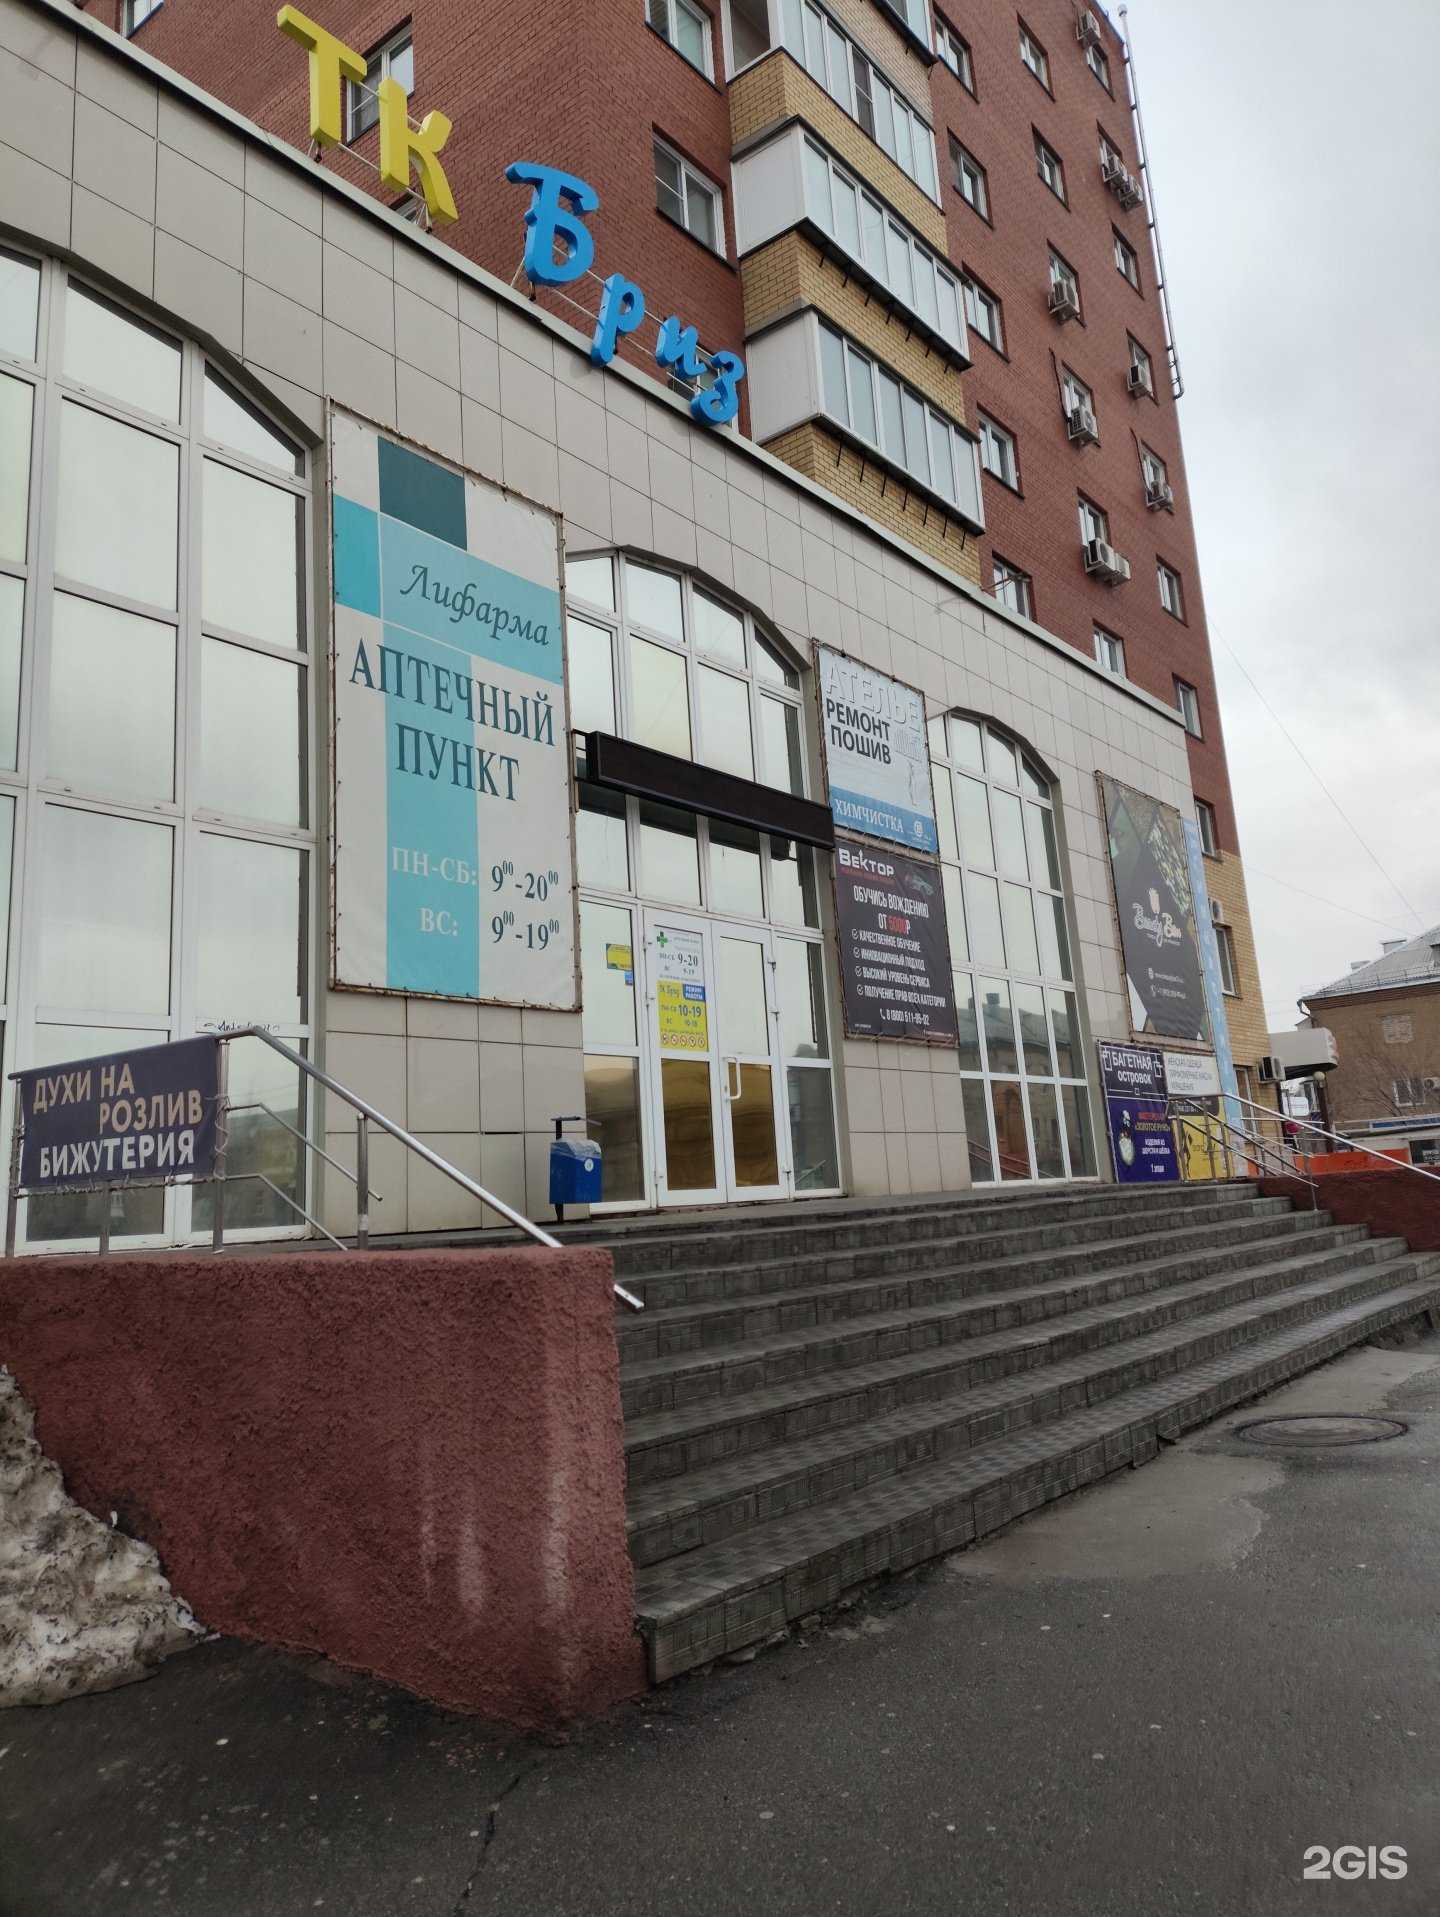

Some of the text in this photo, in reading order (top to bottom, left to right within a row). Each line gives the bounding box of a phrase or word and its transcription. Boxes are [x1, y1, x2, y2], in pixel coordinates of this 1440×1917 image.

[277, 4, 745, 427] ТК Бриз
[400, 563, 549, 647] Лифарма
[349, 636, 556, 748] АПТЕЧНЫЙ
[826, 698, 891, 741] РЕМОНТ
[395, 722, 520, 801] ПУНКТ
[831, 724, 892, 765] ПОШИВ
[834, 799, 904, 833] ХИМЧИСТКА
[391, 846, 477, 886] ПН-СБ:
[419, 907, 459, 936] ВС:
[853, 885, 929, 919] ОБУЧИСЬ ВОЖДЕНИЮ
[678, 1005, 702, 1017] 10-19
[1112, 1052, 1154, 1070] БАГЕТНАЯ
[32, 1063, 135, 1115] ДУХИ НА
[99, 1089, 203, 1134] РОЗЛИВ
[40, 1129, 195, 1178] БИЖУТЕРИЯ
